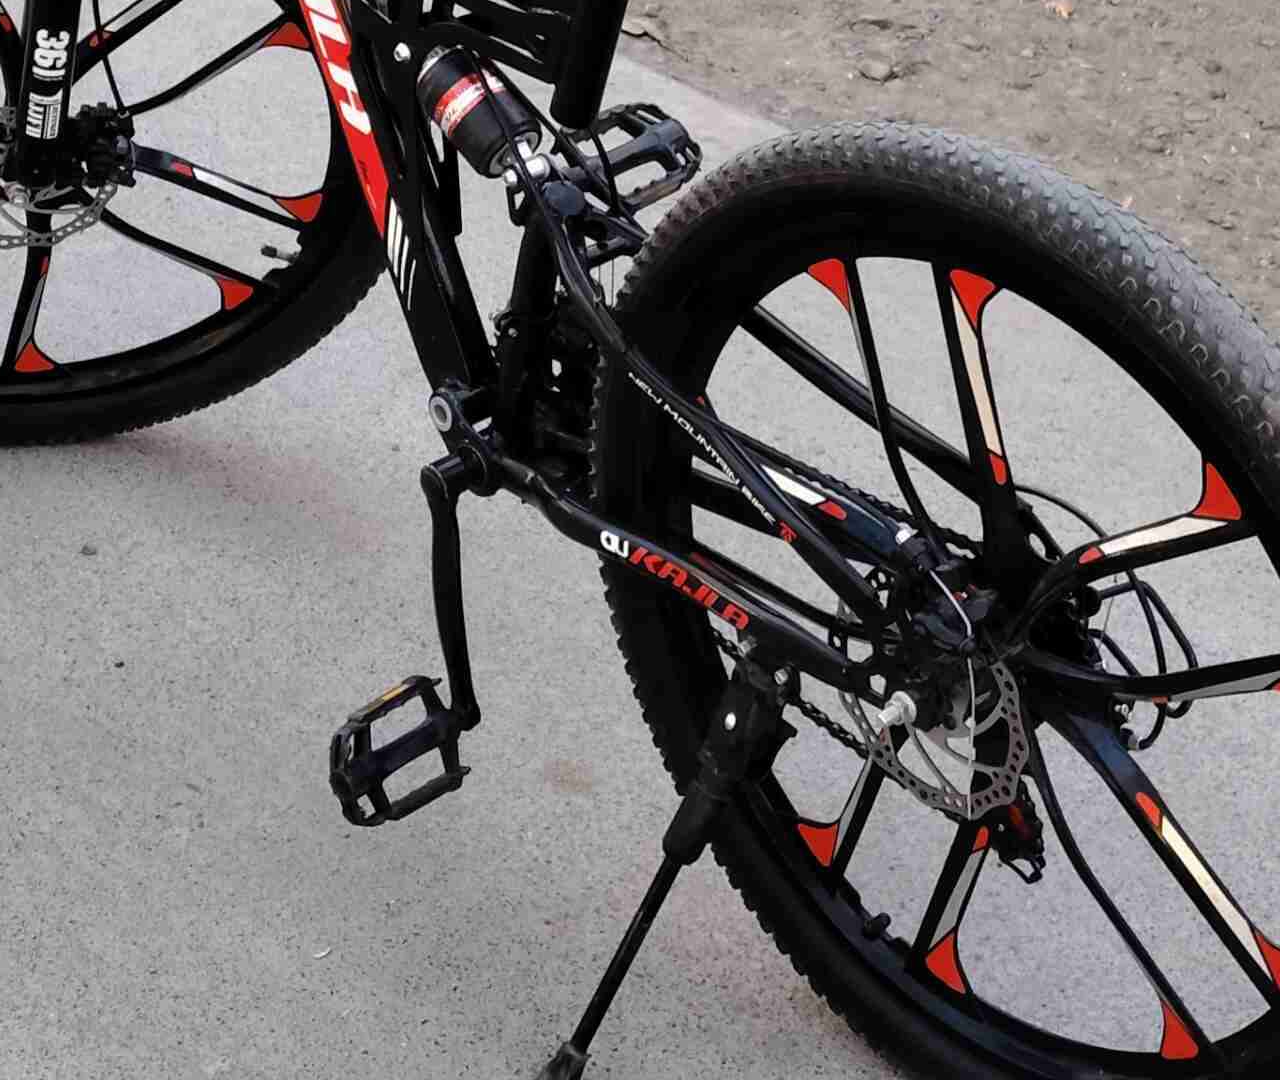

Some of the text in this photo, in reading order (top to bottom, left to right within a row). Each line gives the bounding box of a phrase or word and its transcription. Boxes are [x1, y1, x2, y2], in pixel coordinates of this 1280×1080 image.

[627, 371, 663, 404] NEW
[663, 403, 741, 486] MOUNTAIN
[740, 484, 777, 526] BIKE
